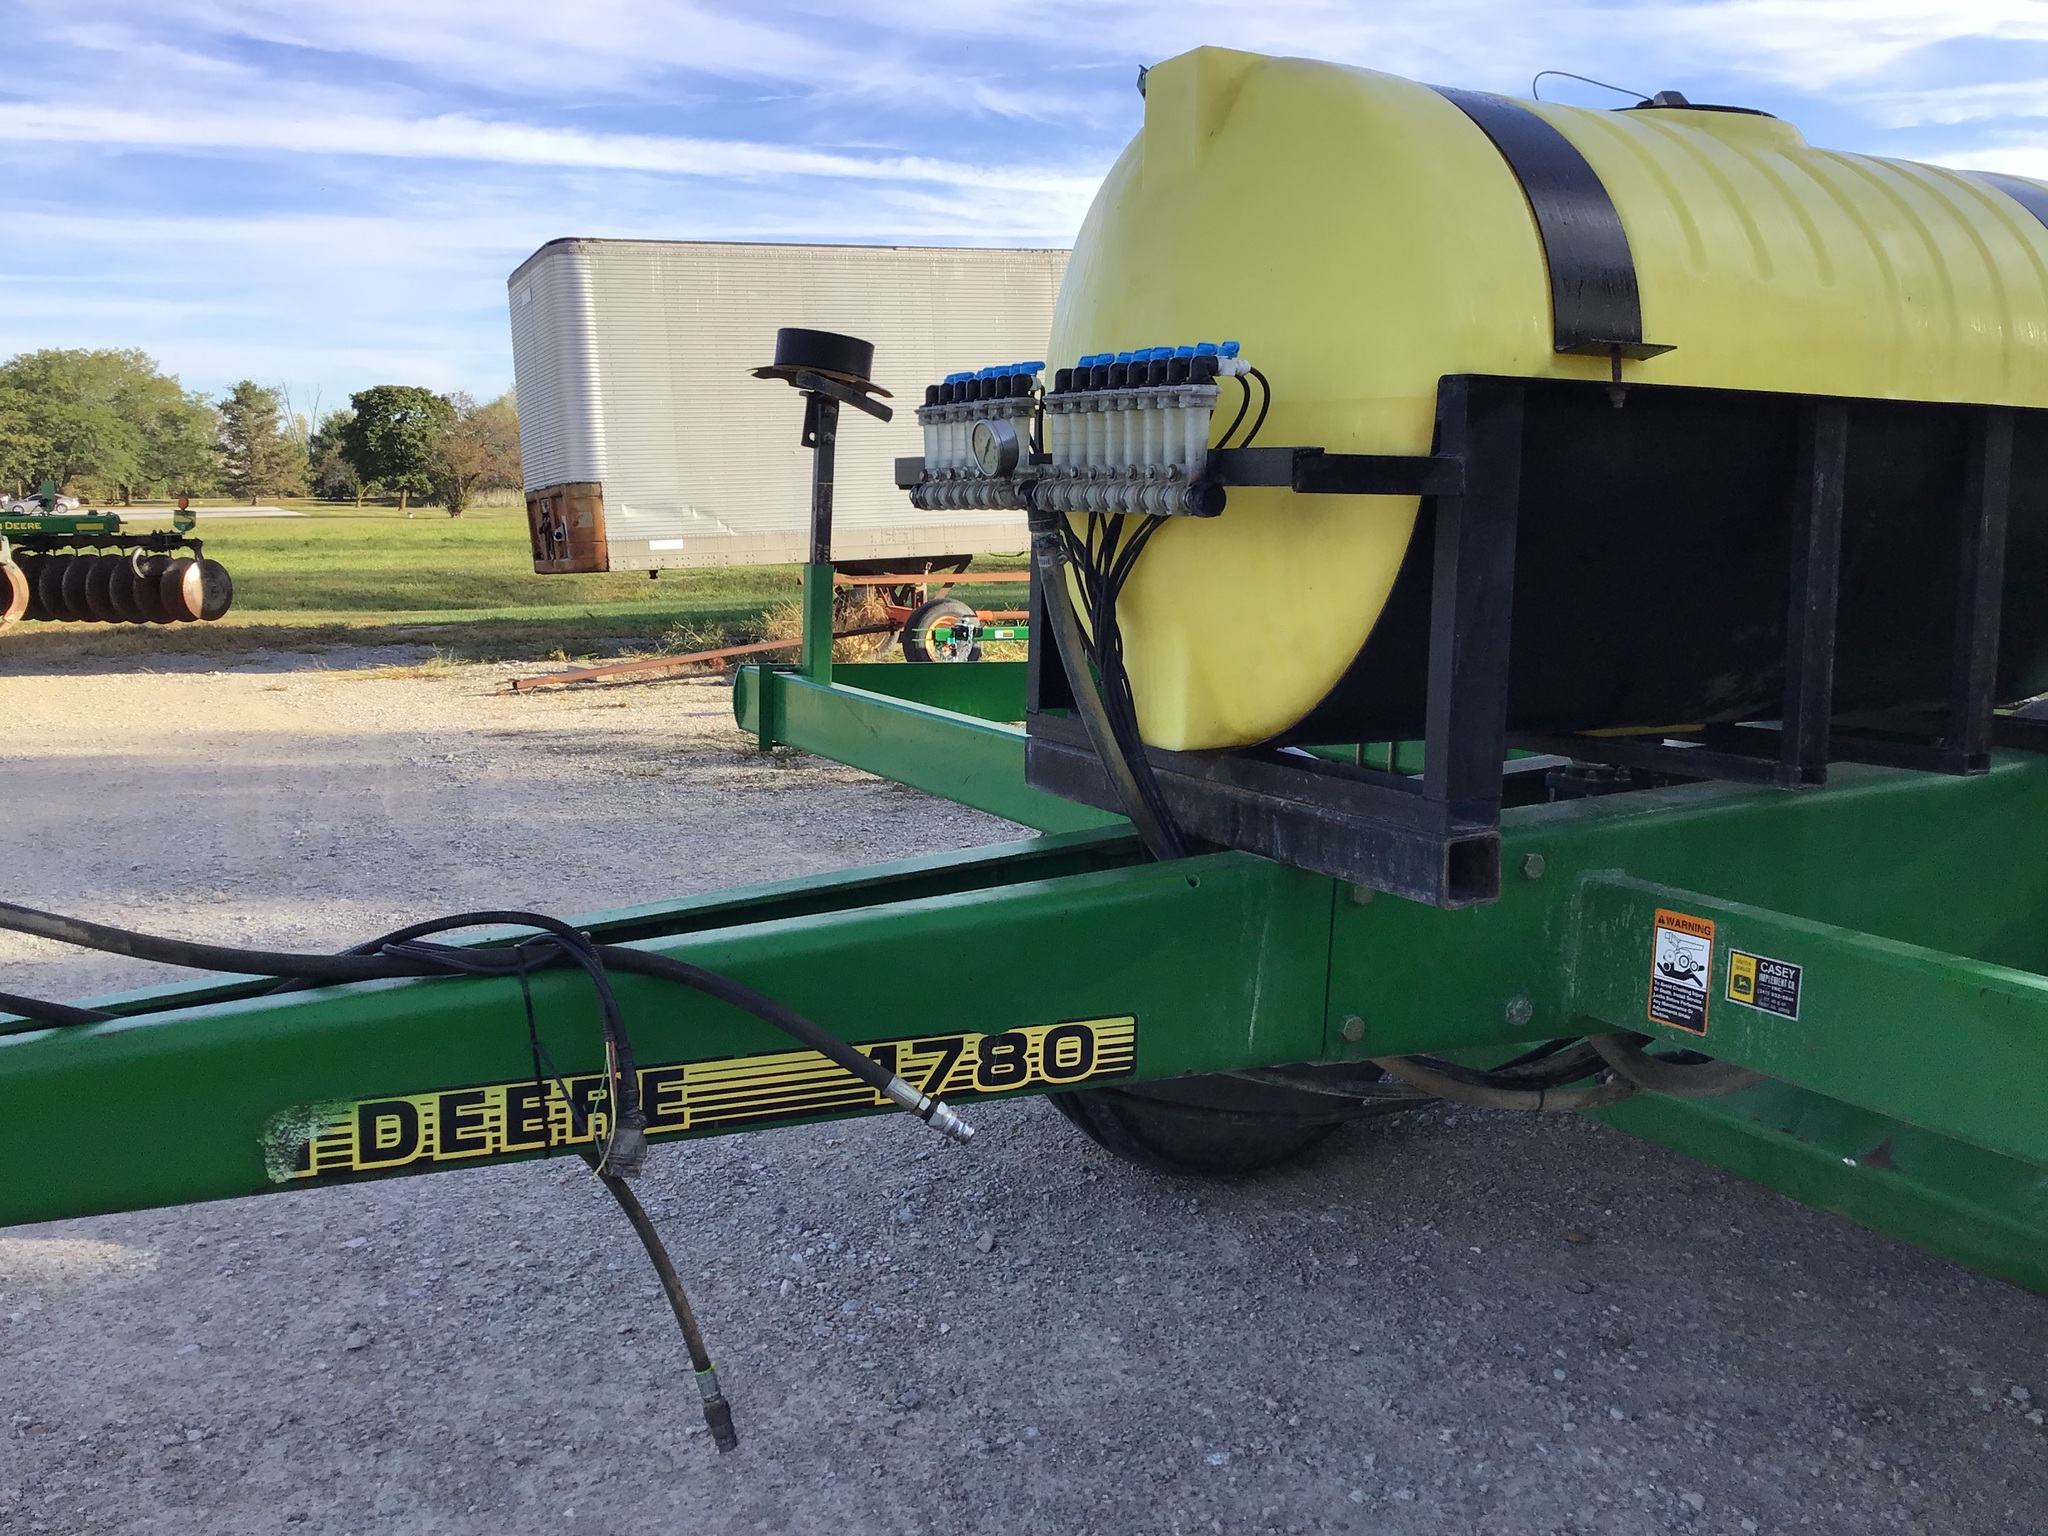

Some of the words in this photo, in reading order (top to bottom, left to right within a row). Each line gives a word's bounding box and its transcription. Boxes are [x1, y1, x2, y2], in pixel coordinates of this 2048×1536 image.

[4, 521, 42, 530] DEERE
[1666, 916, 1712, 936] WARNING
[1760, 961, 1796, 980] CASEY
[1758, 973, 1788, 988] IMPLEMENT
[1672, 985, 1692, 996] Crushing
[1680, 1000, 1704, 1012] Performing
[1686, 995, 1702, 1005] Service
[867, 1022, 1097, 1105] 1780
[356, 1066, 691, 1170] DEERE
